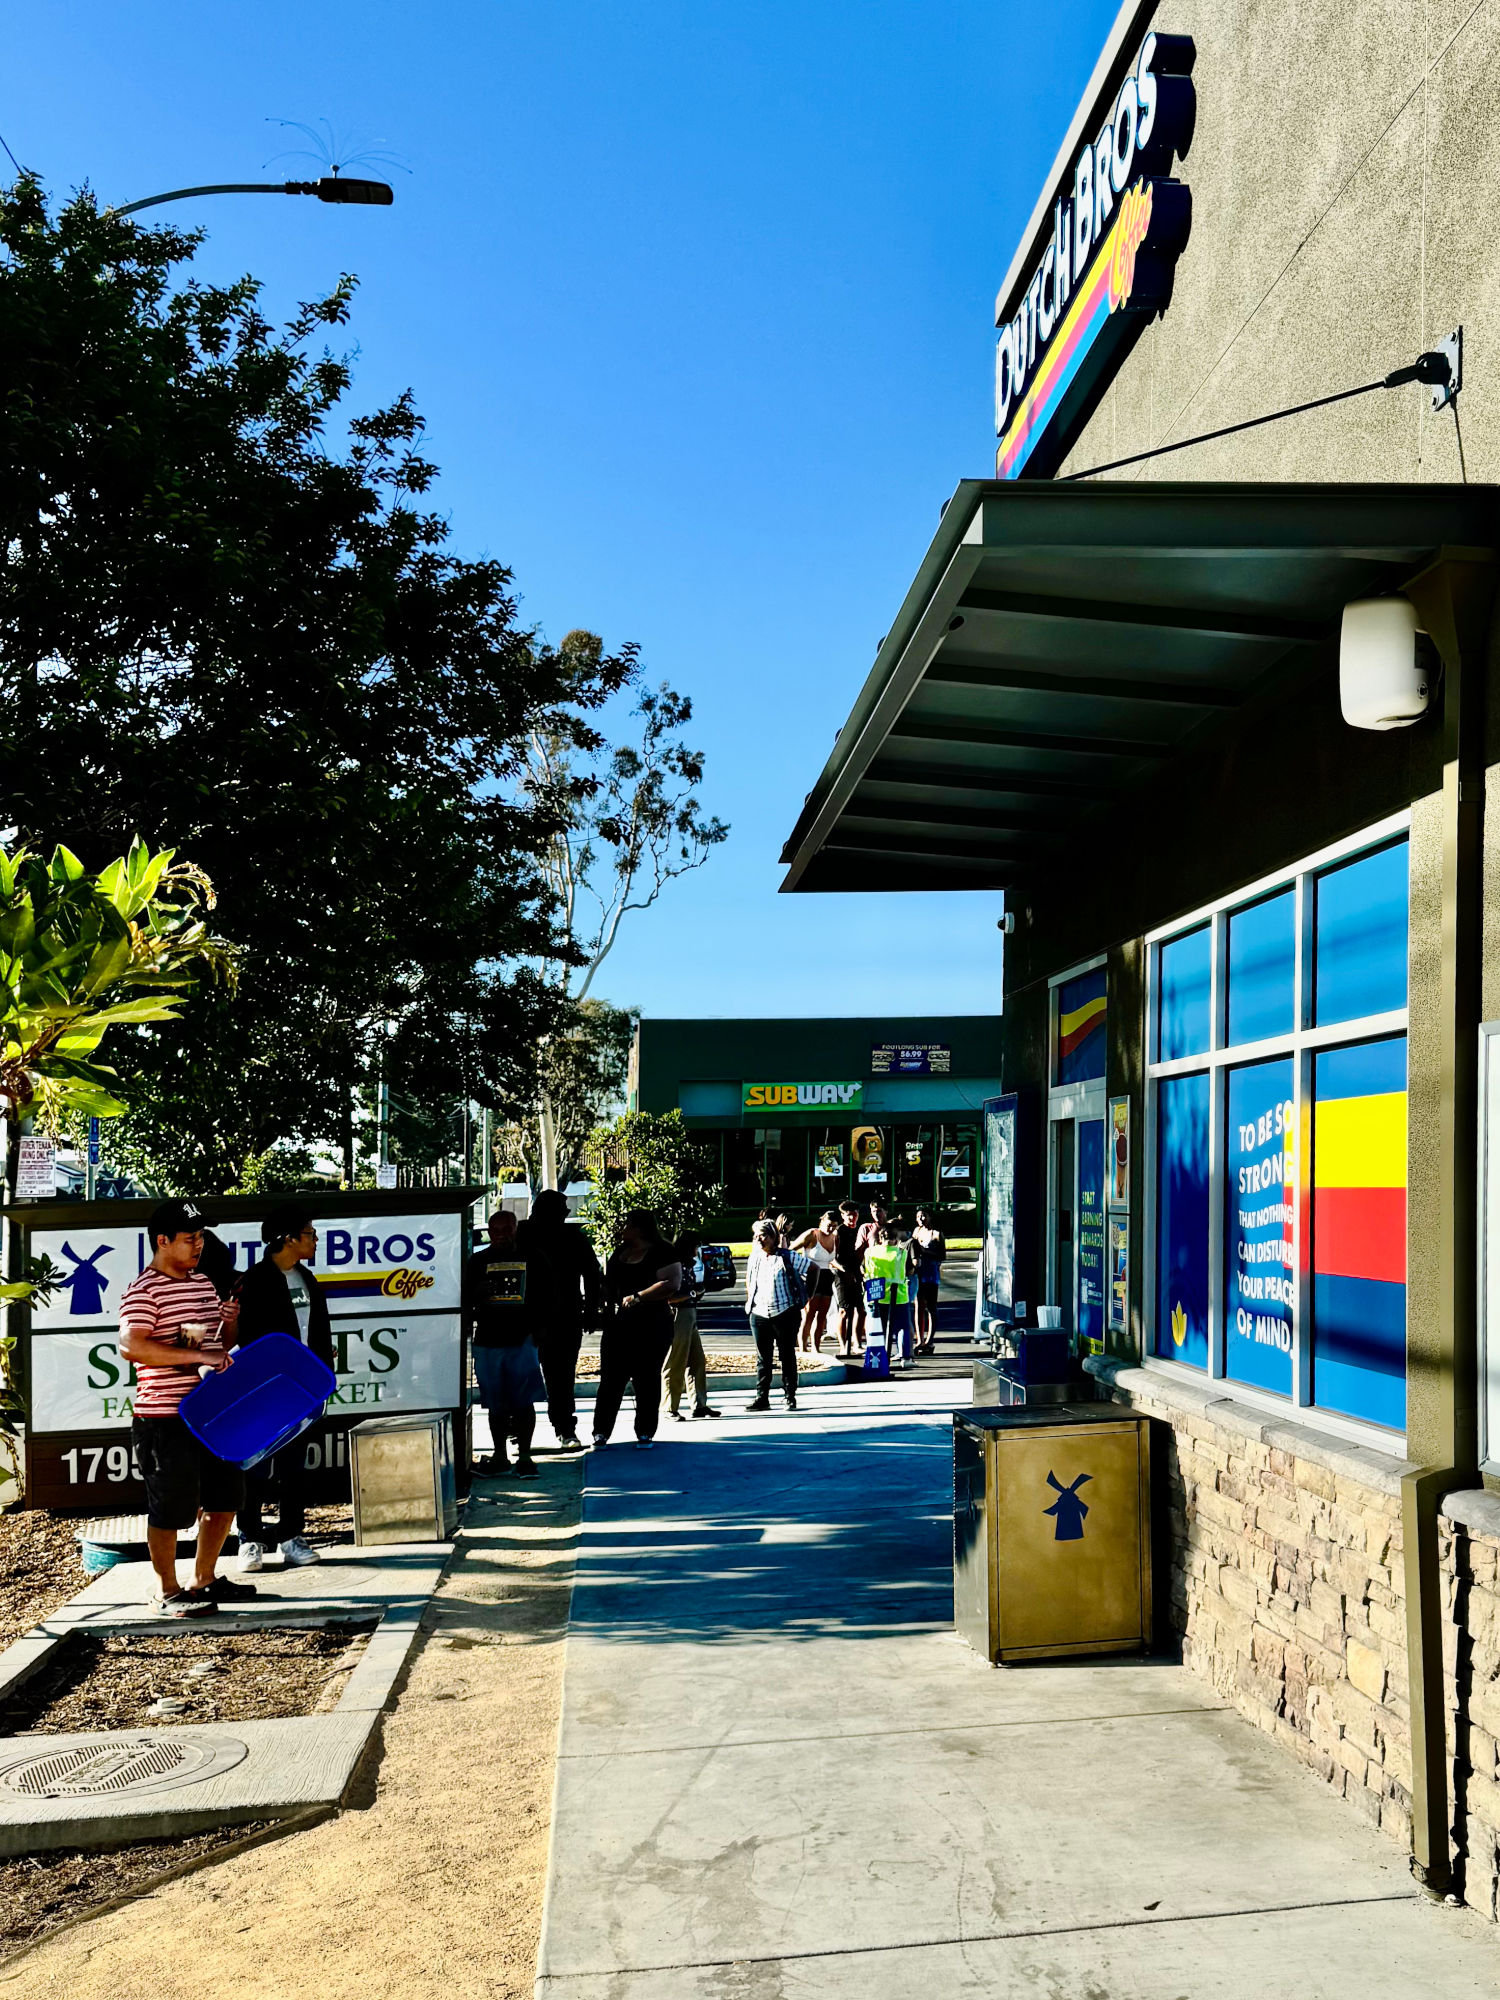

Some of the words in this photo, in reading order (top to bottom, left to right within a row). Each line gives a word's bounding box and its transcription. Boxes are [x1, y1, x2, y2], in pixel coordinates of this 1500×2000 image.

[900, 1050, 922, 1058] $6.99
[745, 1081, 862, 1106] SUBWAY
[1239, 1122, 1255, 1152] TO
[1257, 1109, 1273, 1147] BE
[1275, 1099, 1294, 1136] SO
[1238, 1151, 1294, 1194] STRONG
[1239, 1207, 1256, 1228] THAT
[1256, 1202, 1294, 1227] NOTHING
[1238, 1241, 1256, 1263] CAN
[1256, 1239, 1294, 1266] DISTURB
[382, 1268, 434, 1299] Coffee
[1237, 1269, 1263, 1300] YOUR
[1264, 1275, 1294, 1308] PEACE
[1236, 1307, 1253, 1340] OF
